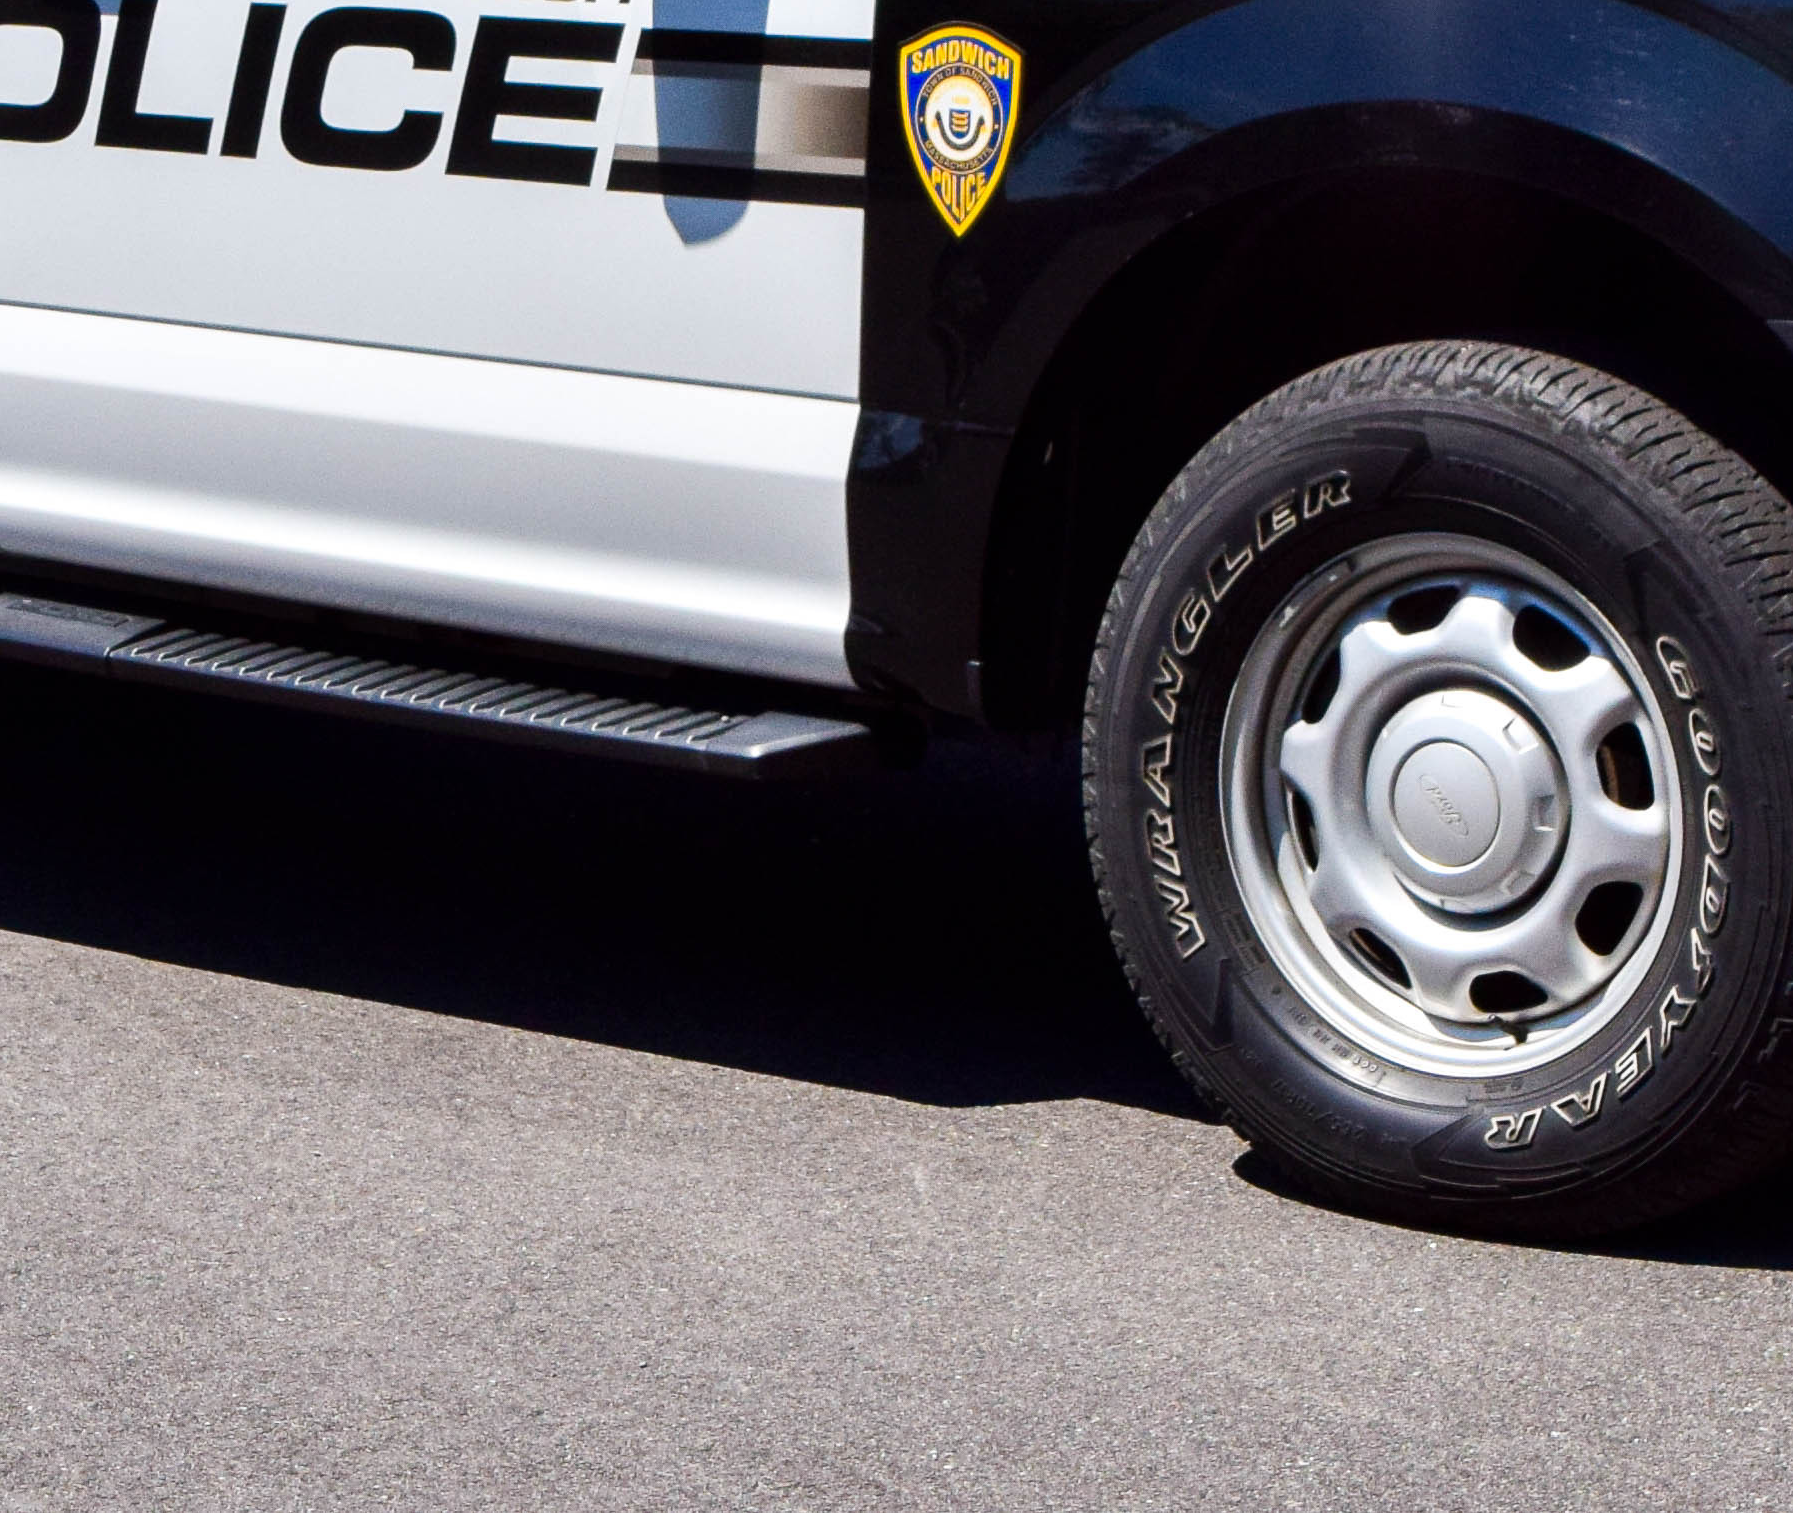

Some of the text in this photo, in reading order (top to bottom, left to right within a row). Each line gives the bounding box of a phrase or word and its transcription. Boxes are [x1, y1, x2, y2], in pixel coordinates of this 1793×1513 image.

[910, 39, 1011, 80] SANDWICH
[922, 71, 944, 97] TOWN
[944, 66, 956, 76] OF
[931, 165, 987, 222] POLICE
[1140, 468, 1352, 960] WRANGLER
[1483, 634, 1733, 1151] GOODYEAR
